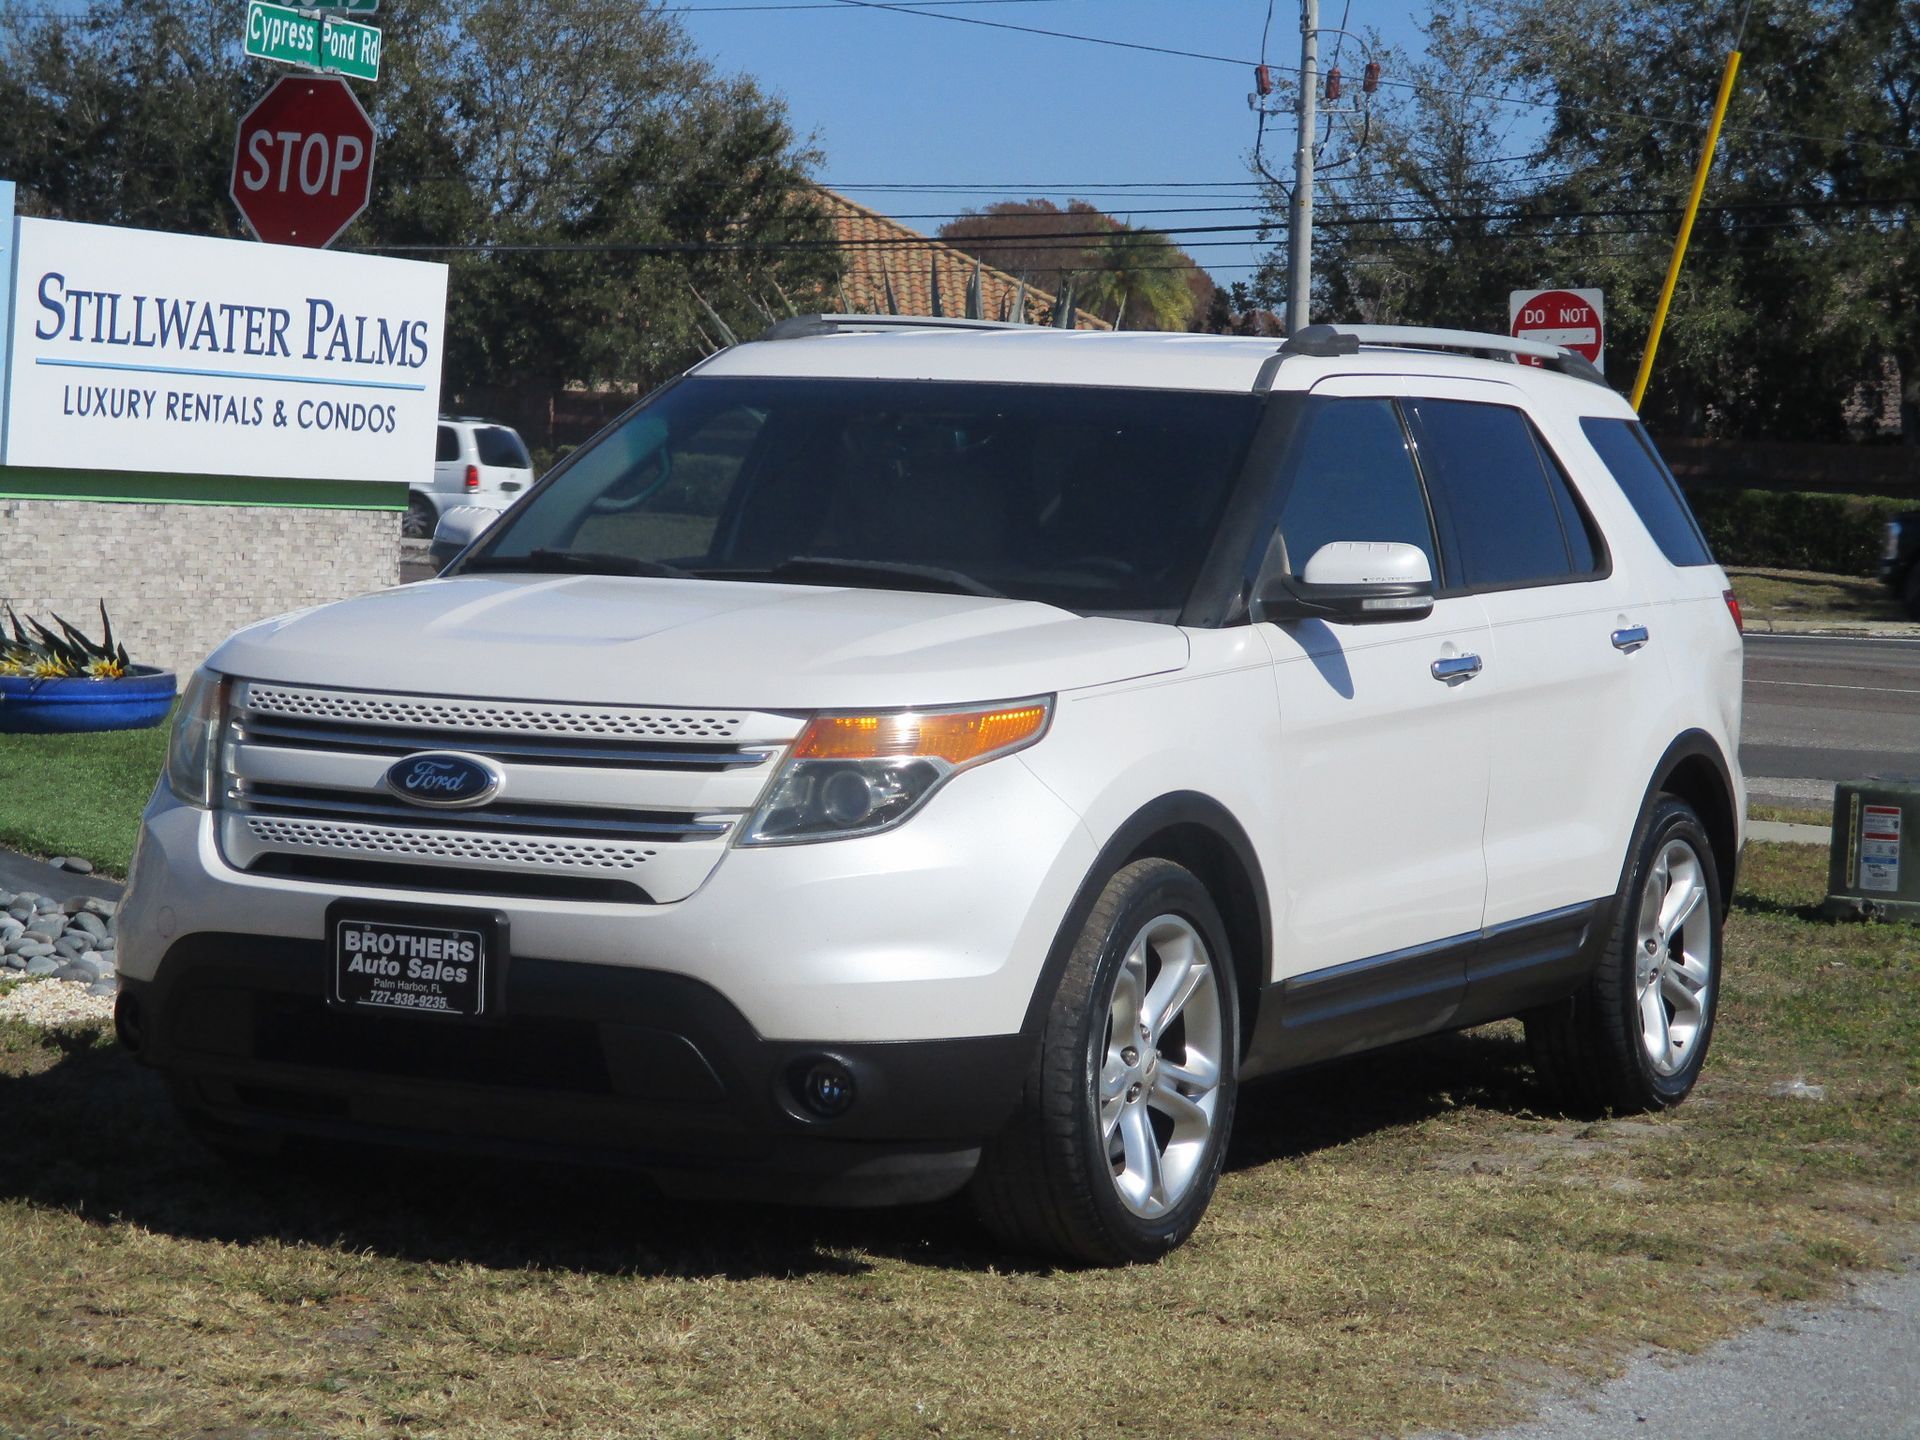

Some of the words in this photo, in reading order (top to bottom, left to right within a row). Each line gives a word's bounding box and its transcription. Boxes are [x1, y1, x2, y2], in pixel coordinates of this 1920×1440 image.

[250, 7, 314, 52] Cypress
[323, 22, 356, 61] Pond
[361, 31, 378, 66] Rd
[243, 129, 363, 196] STOP
[35, 272, 291, 357] STILLWATER
[302, 298, 428, 368] PALMS
[1524, 309, 1546, 324] DO
[1560, 308, 1589, 323] NOT
[63, 385, 157, 419] LUXURY
[166, 392, 264, 427] RENTALS
[273, 400, 288, 427] &
[298, 400, 396, 434] CONDOS
[405, 761, 468, 791] Ford
[345, 930, 474, 962] BROTHERS
[347, 952, 401, 976] Auto
[407, 957, 468, 983] Sales
[370, 990, 447, 1010] 727-938-9235
[373, 977, 396, 989] Palm
[398, 980, 429, 993] Harbor,
[431, 983, 442, 993] FL
